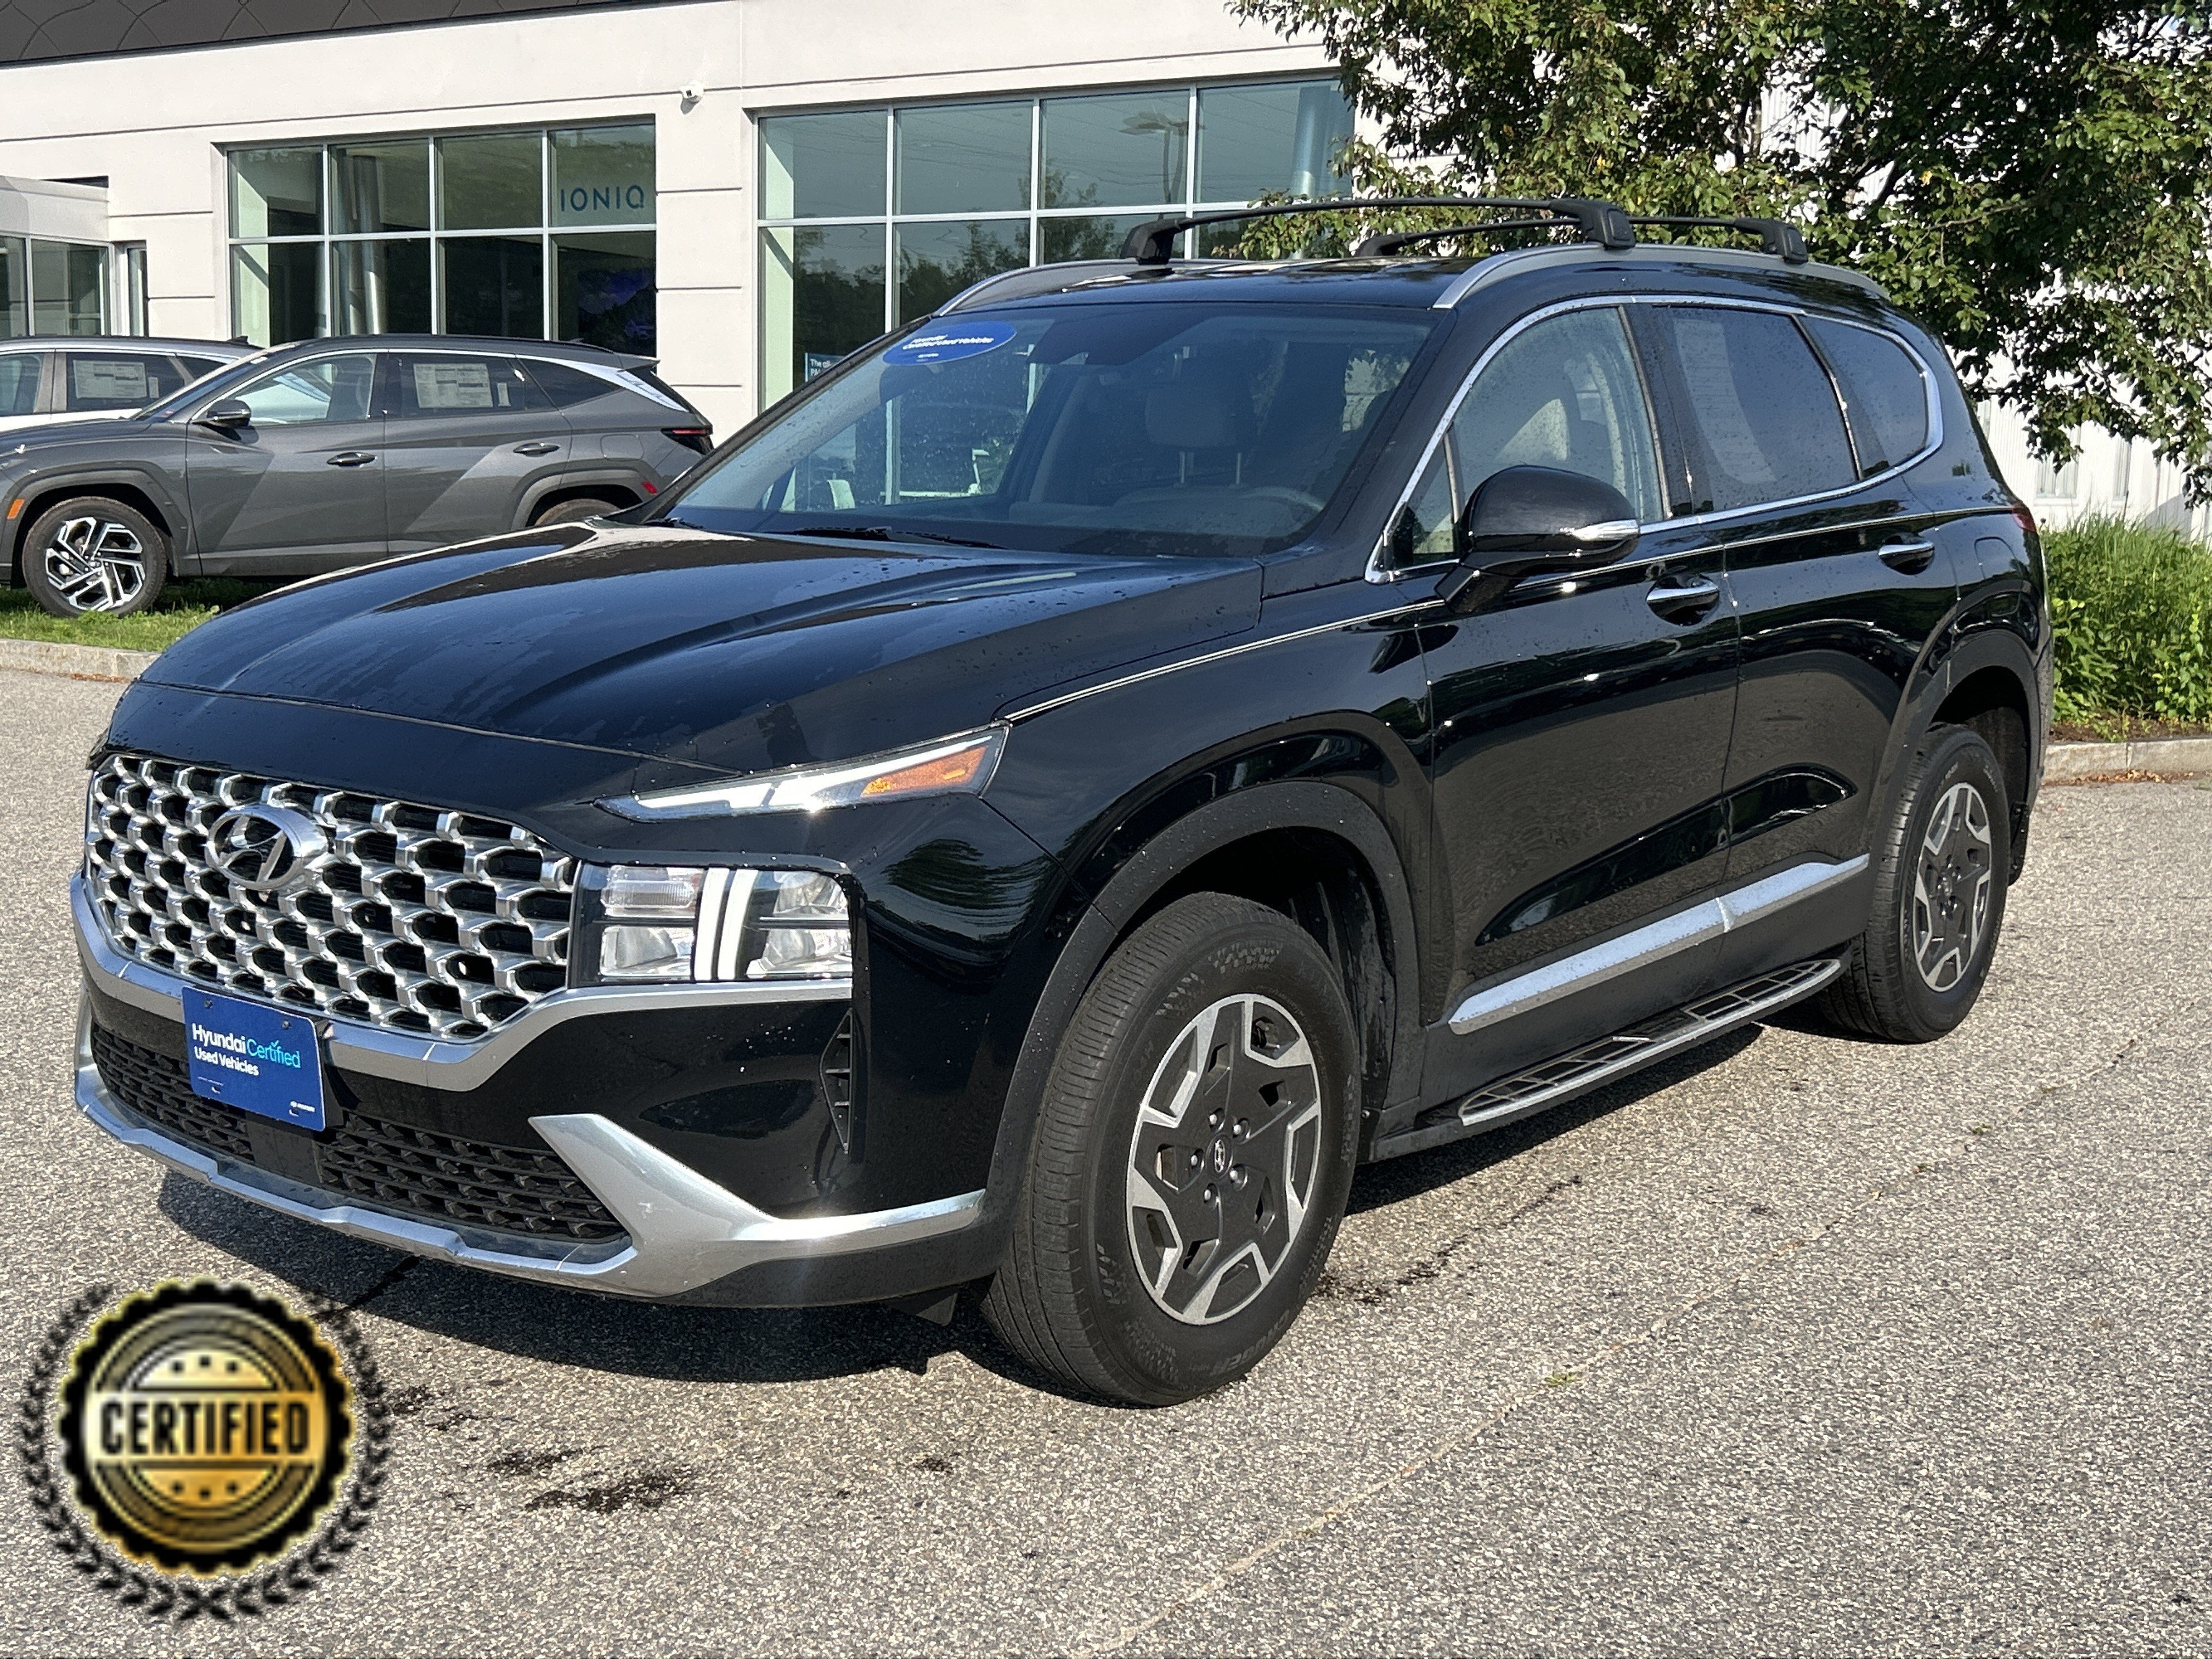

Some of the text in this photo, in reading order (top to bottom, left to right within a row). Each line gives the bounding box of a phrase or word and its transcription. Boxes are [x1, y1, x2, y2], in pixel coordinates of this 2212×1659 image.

[560, 184, 645, 212] IONIQ
[192, 1023, 301, 1068] Hyundai Certified
[194, 1046, 259, 1076] Used Vehicles
